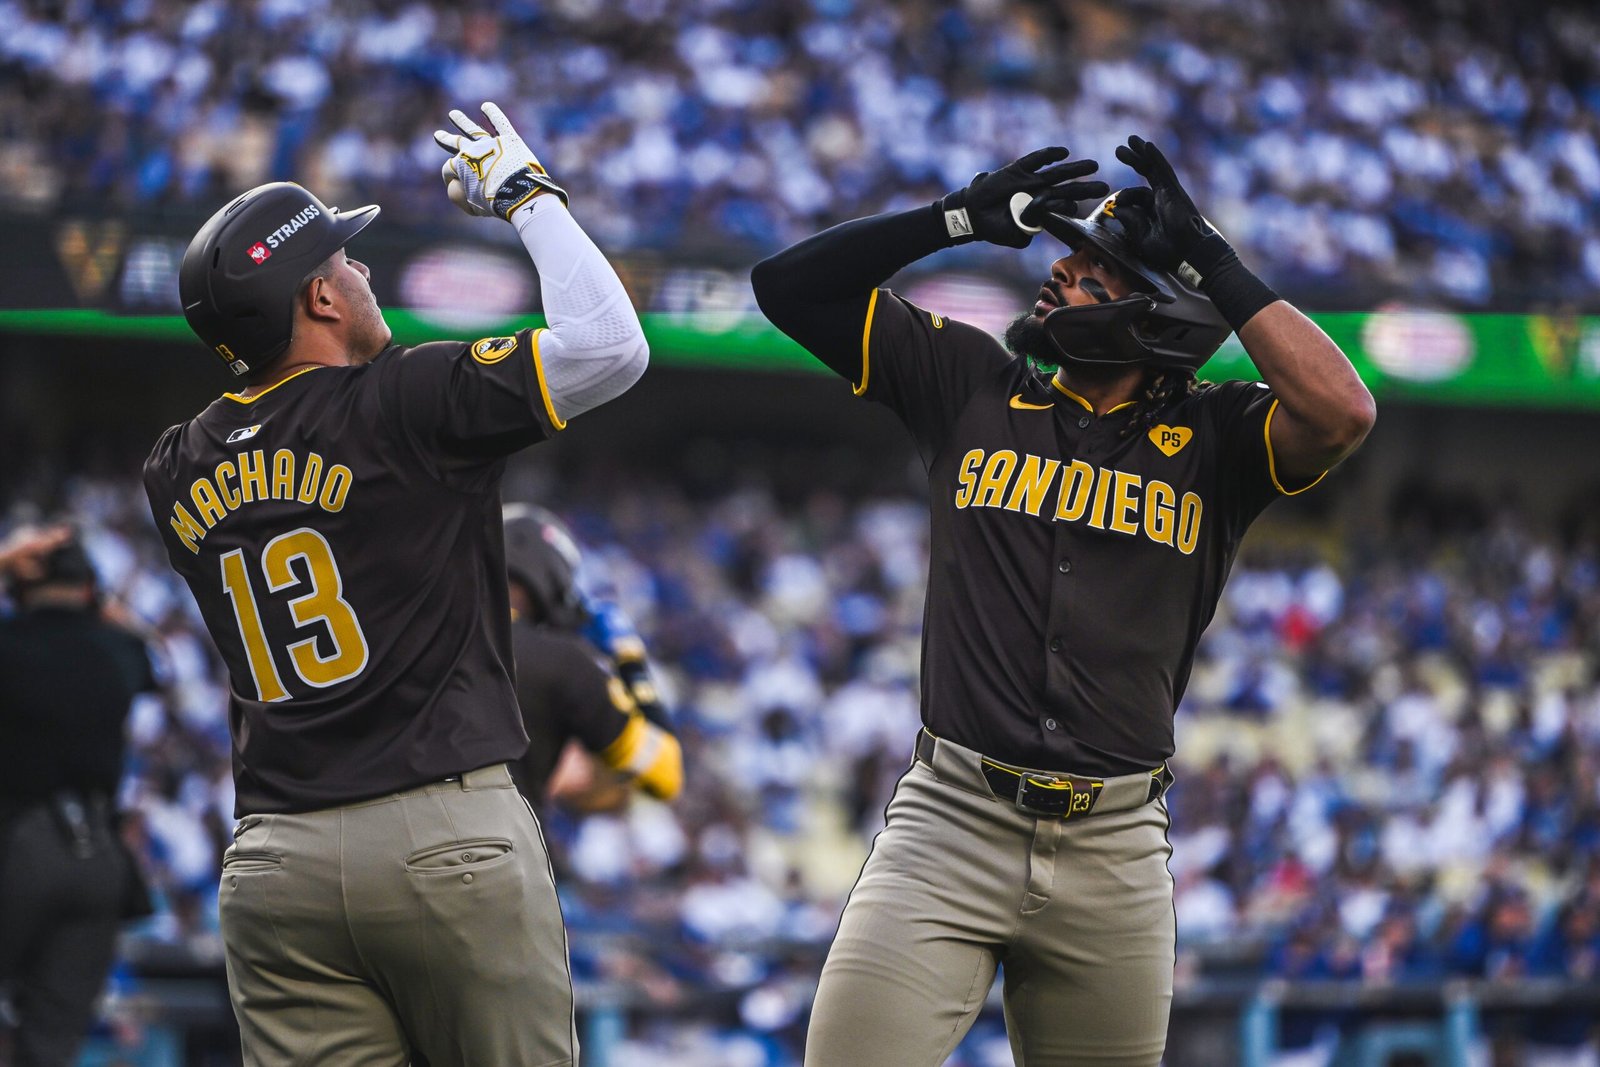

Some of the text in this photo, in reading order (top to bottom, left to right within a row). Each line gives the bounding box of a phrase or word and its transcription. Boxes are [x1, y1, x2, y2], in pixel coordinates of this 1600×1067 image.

[266, 203, 320, 249] STRAUSS
[1161, 431, 1181, 448] PS
[170, 448, 353, 555] MACHADO
[955, 448, 1203, 555] SAN DIEGO
[220, 527, 370, 702] 13
[1072, 793, 1090, 812] 23
